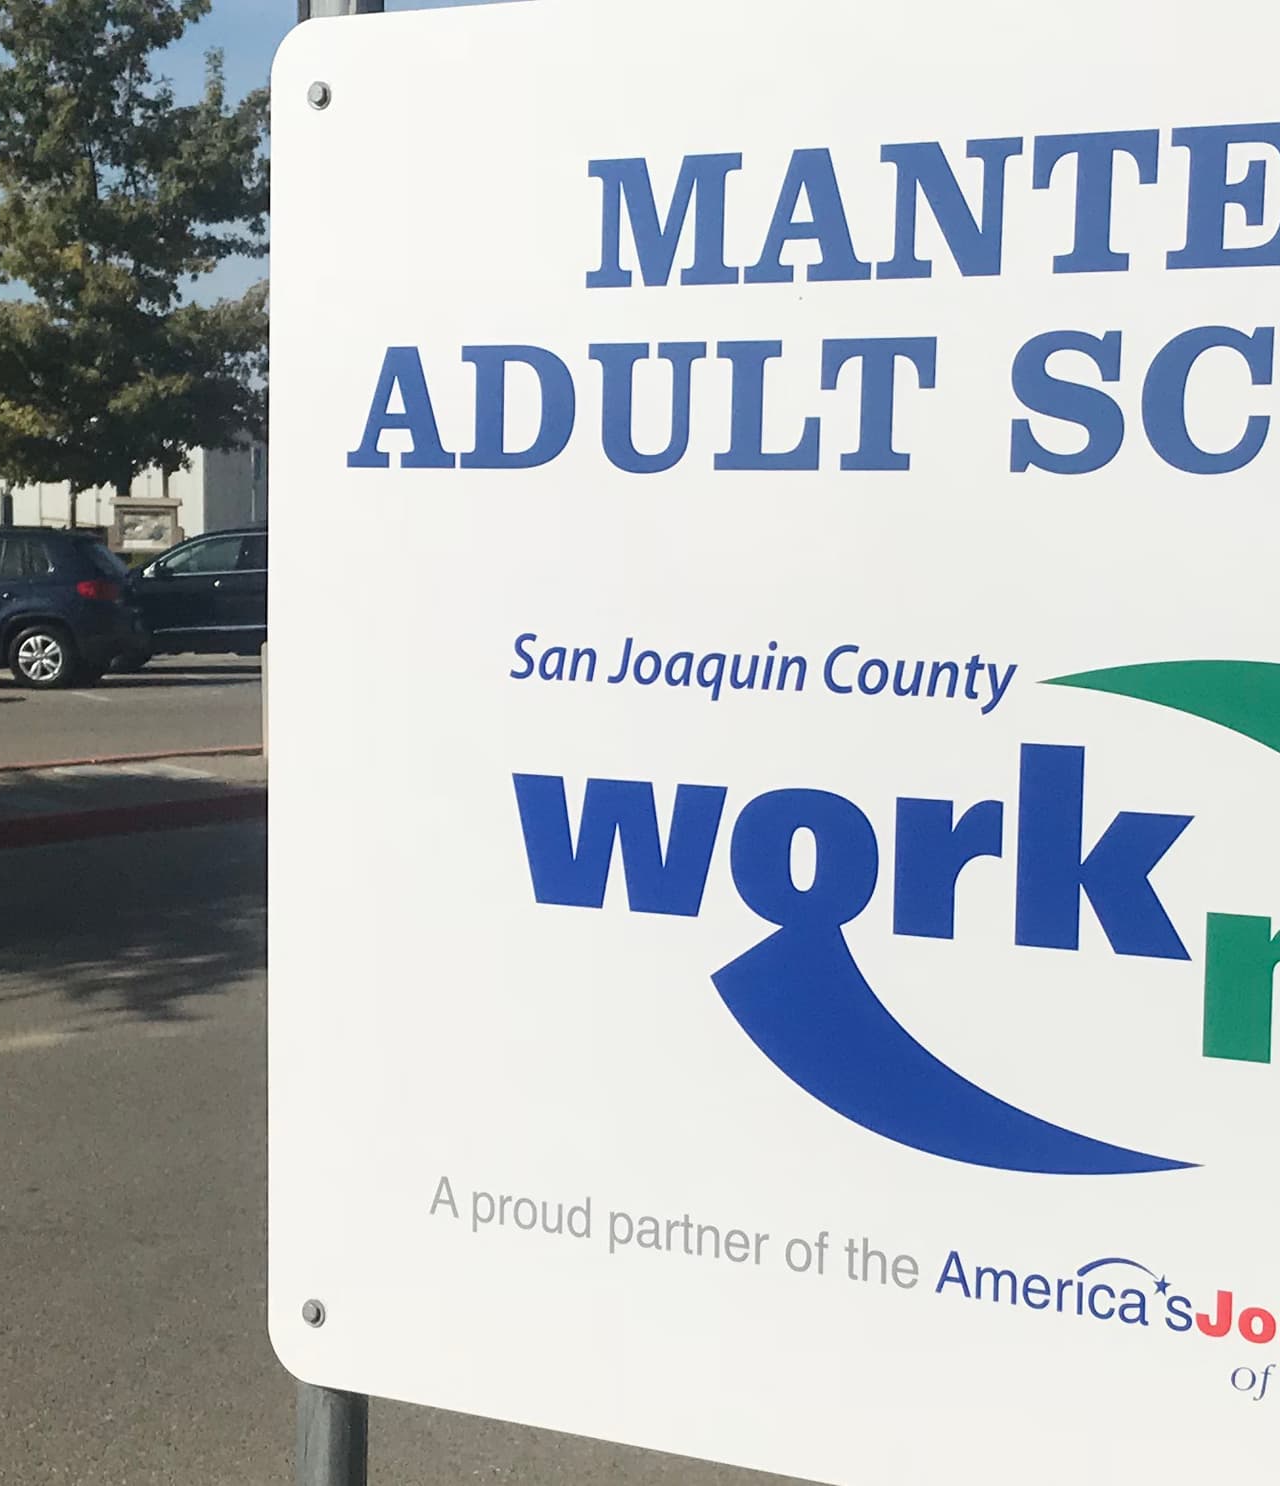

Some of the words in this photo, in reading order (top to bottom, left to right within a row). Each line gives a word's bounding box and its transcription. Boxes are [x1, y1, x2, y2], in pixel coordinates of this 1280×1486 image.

[347, 336, 937, 475] ADULT
[509, 632, 598, 683] San
[606, 636, 808, 702] Joaquin
[823, 643, 1019, 716] County
[430, 1176, 459, 1219] A
[472, 1191, 592, 1239] proud
[609, 1211, 770, 1265] partner
[785, 1231, 829, 1275] of
[844, 1237, 919, 1290] the
[1230, 1363, 1277, 1402] of
